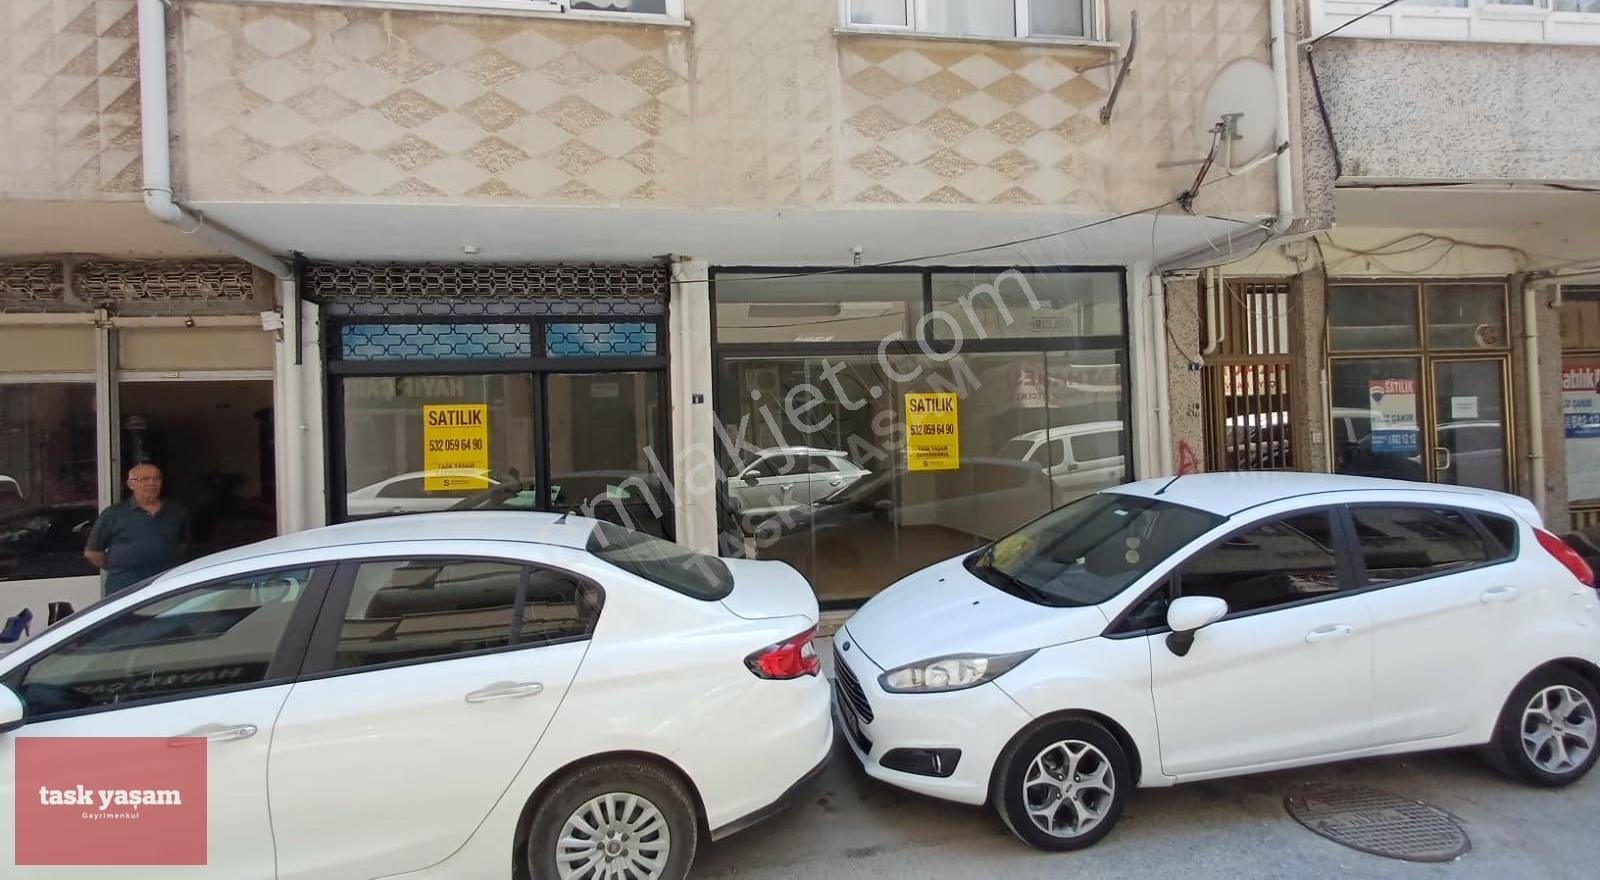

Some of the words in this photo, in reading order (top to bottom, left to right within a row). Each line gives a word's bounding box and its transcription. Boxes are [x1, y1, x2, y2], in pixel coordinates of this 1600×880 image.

[909, 397, 953, 412] SATILIK
[428, 409, 482, 426] SATILIK
[910, 424, 923, 435] 532
[936, 424, 945, 435] 64
[945, 424, 954, 435] 90
[429, 439, 443, 451] 532
[445, 439, 460, 451] 059
[461, 439, 471, 450] 64
[472, 438, 482, 450] 90
